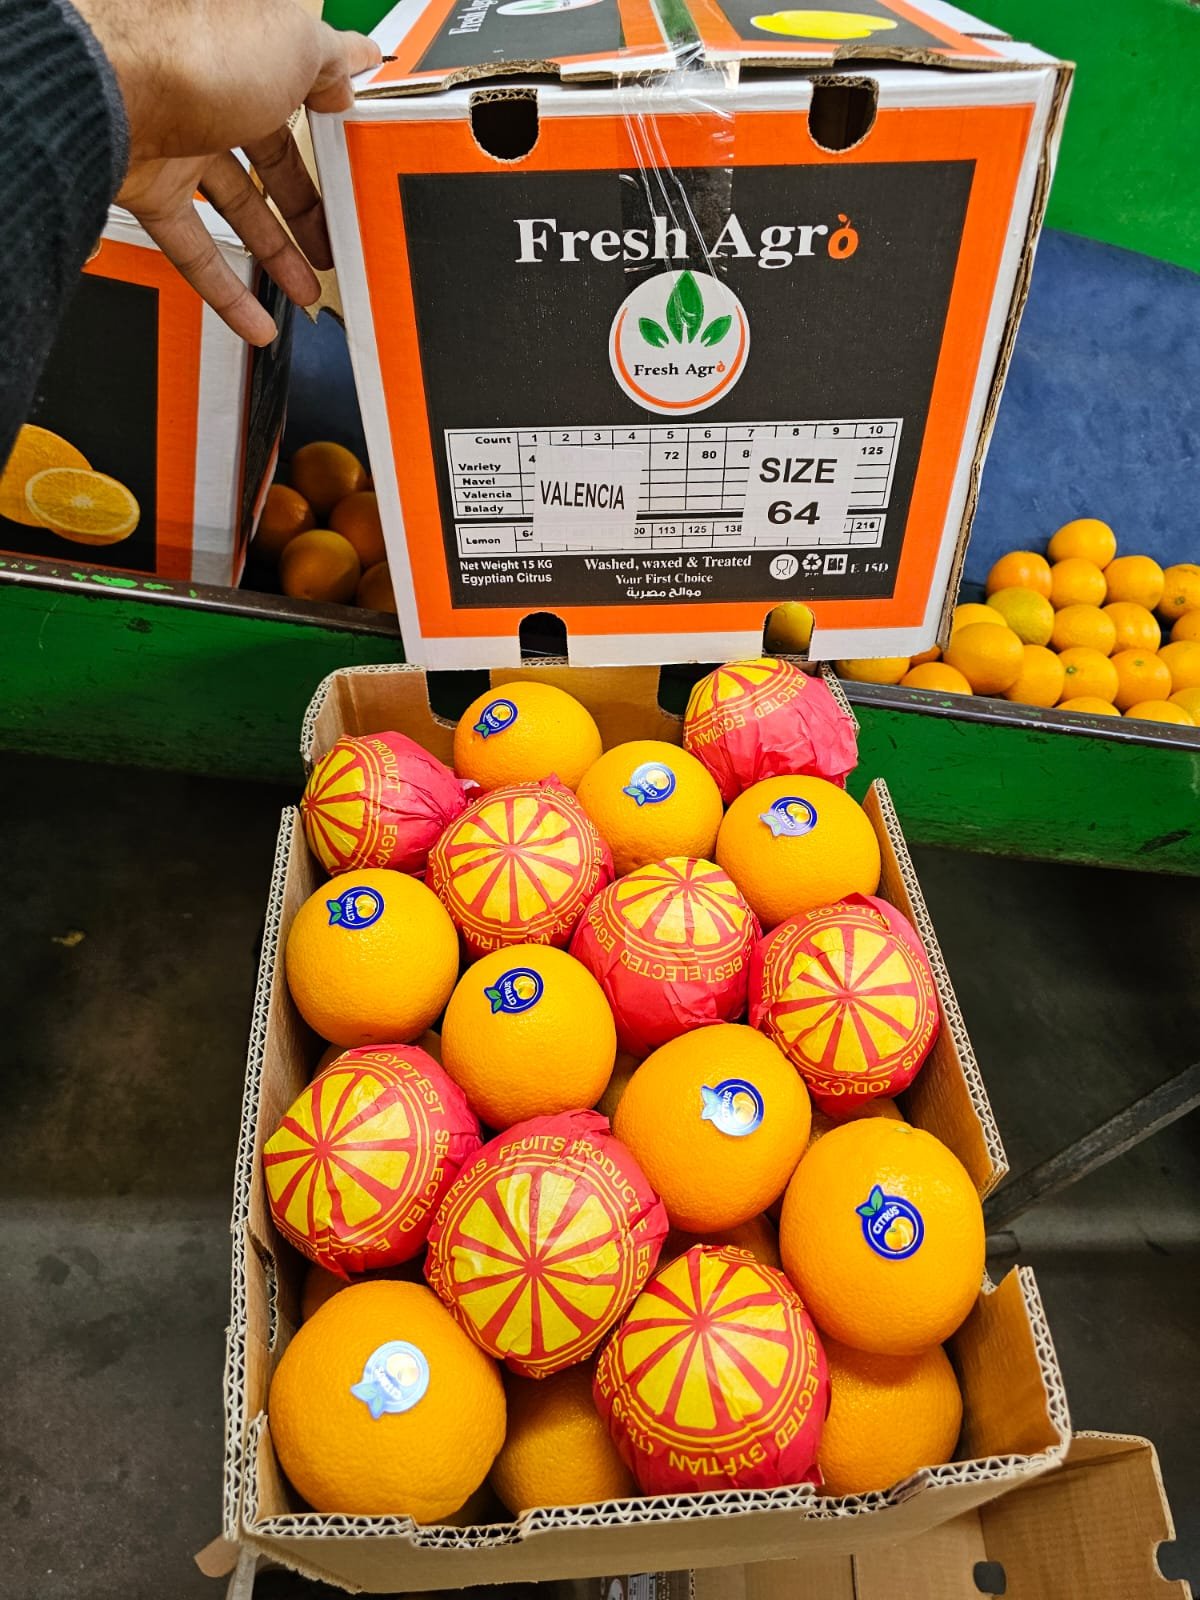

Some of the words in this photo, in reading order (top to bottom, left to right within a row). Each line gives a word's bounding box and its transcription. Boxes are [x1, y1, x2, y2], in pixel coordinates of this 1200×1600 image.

[513, 216, 690, 263] Fresh
[634, 362, 679, 376] Fresh
[475, 435, 512, 445] Count
[531, 434, 538, 443] 1
[562, 433, 570, 442] 2
[593, 432, 602, 441] 3
[628, 431, 636, 441] 4
[667, 431, 674, 440] 5
[704, 430, 711, 439] 6
[747, 428, 755, 438] 7
[792, 427, 800, 436] 8
[832, 426, 840, 435] 9
[868, 425, 884, 435] 10
[528, 454, 537, 463] 4
[664, 451, 680, 460] 72
[702, 450, 717, 459] 80
[742, 449, 752, 458] 8
[860, 446, 884, 455] 125
[458, 462, 502, 473] Variety
[759, 457, 838, 484] SIZE
[462, 477, 496, 486] Navel
[462, 489, 512, 499] Valencia
[540, 480, 625, 510] VALENCIA
[464, 504, 504, 514] Balady
[767, 500, 820, 525] 64
[466, 536, 501, 545] Lemon
[658, 526, 676, 535] 113
[688, 525, 707, 534] 125
[460, 561, 479, 571] Net
[480, 560, 519, 571] Weight
[522, 560, 534, 569] 15
[537, 560, 553, 569] KG
[584, 558, 639, 571] Washed,
[642, 557, 683, 569] waxed
[686, 556, 698, 568] &
[702, 555, 752, 567] Treated
[462, 573, 514, 586] Egyptian
[516, 572, 552, 583] Citrus
[615, 574, 642, 585] Your
[645, 573, 671, 584] First
[674, 572, 713, 583] Choice
[626, 586, 666, 599] مصرية
[668, 587, 702, 598] موالح
[754, 674, 808, 718] ELECTED
[376, 824, 398, 868] EGYP
[620, 949, 701, 982] ELECTED
[706, 956, 743, 984] BEST
[762, 924, 798, 1000] ELECTED
[902, 1010, 935, 1071] FRUITS
[399, 1129, 449, 1233] SELECTED
[873, 1206, 900, 1235] CITRUS
[775, 1328, 820, 1450] SELECTED
[669, 1442, 769, 1476] GYPTIAN
